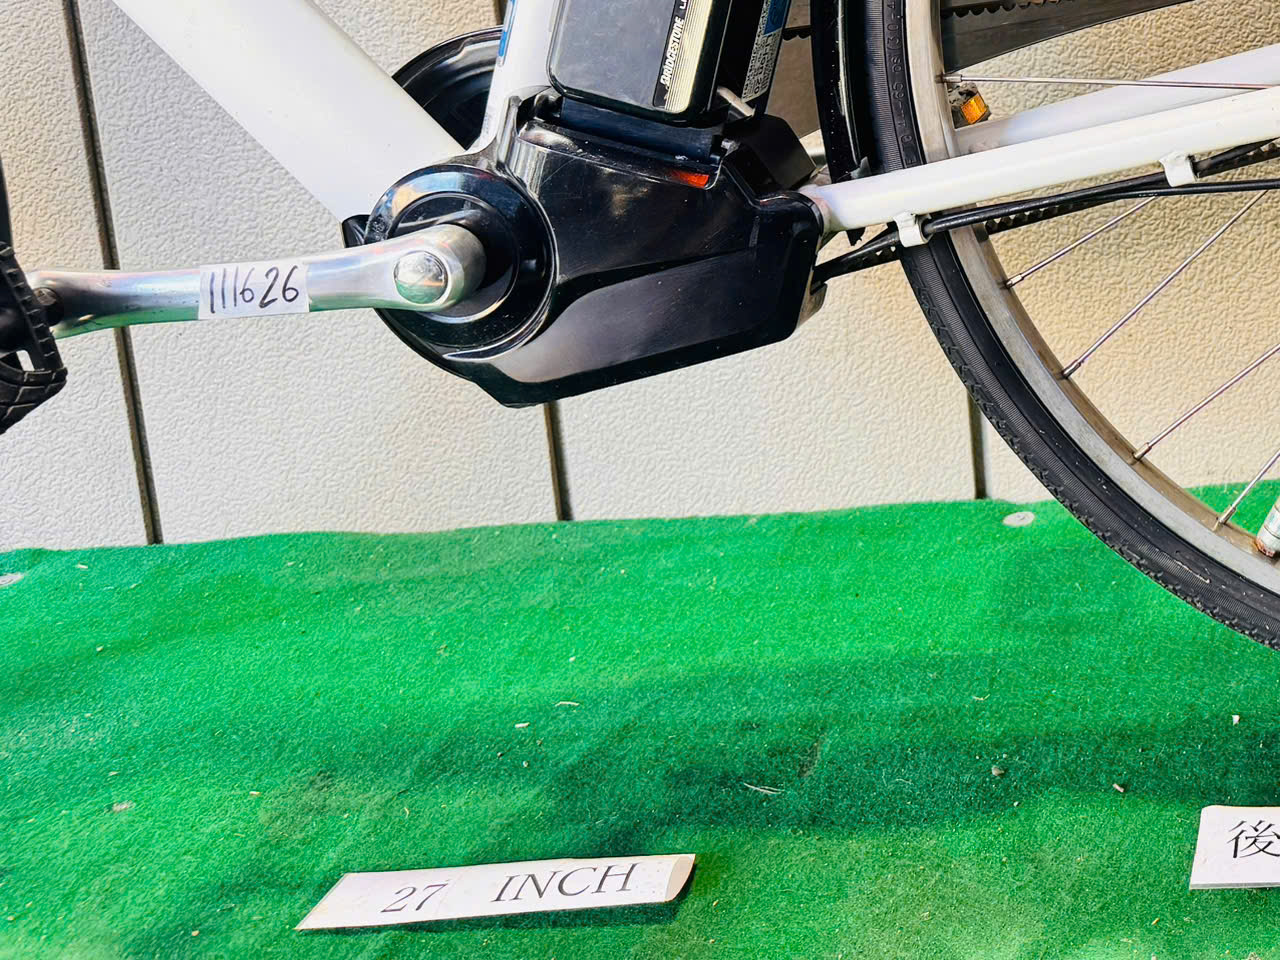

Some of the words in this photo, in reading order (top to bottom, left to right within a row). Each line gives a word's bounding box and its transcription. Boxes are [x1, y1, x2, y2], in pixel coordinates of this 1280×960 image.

[659, 16, 684, 85] BRIDGESTONE
[209, 265, 300, 314] 111626
[380, 882, 449, 913] 27
[490, 862, 640, 903] INCH
